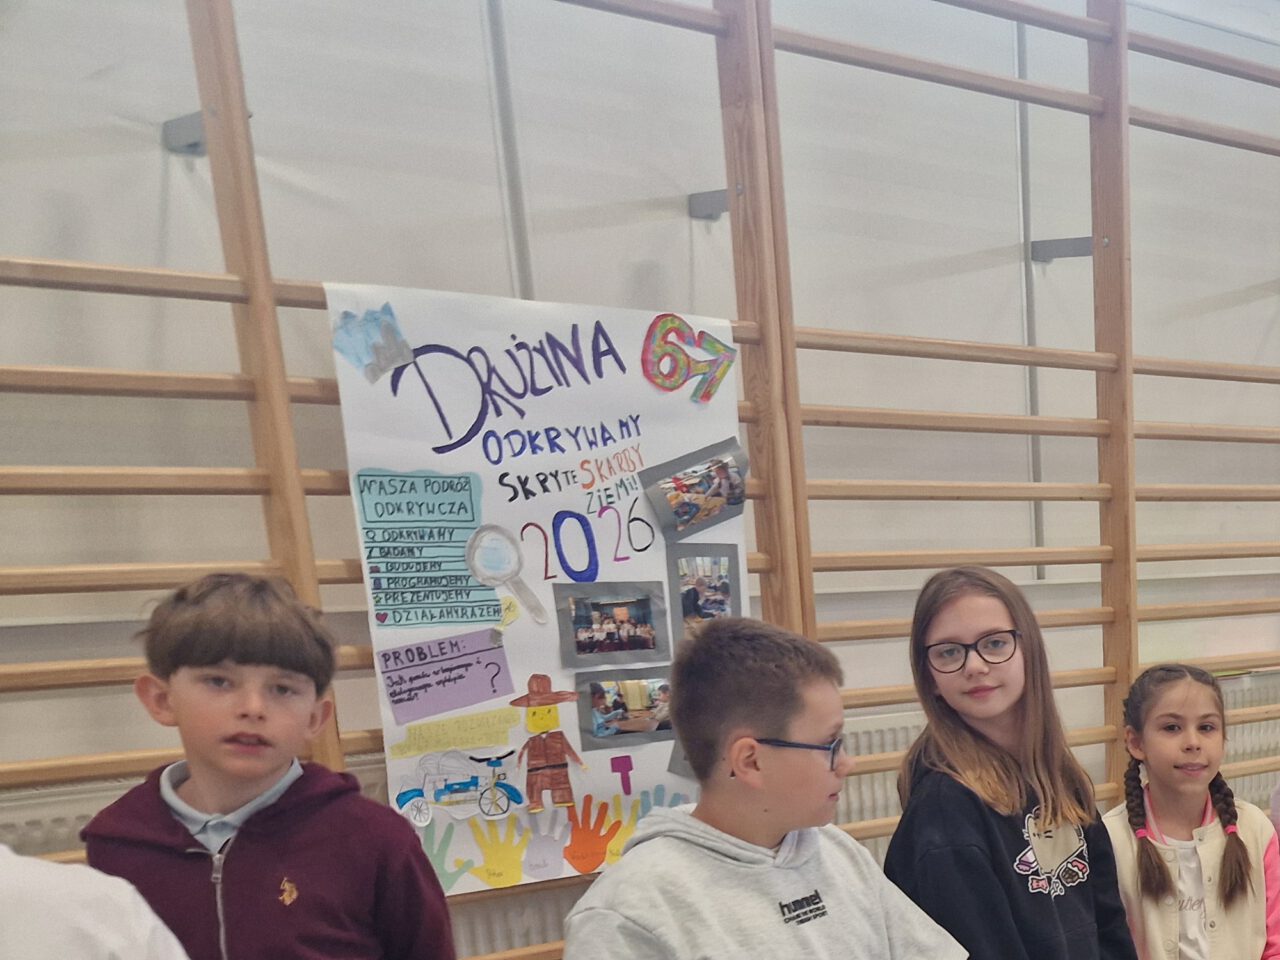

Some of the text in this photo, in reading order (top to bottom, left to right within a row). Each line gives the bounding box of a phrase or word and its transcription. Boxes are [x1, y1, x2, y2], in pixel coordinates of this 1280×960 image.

[391, 312, 738, 455] DRUŻYNA 67
[482, 413, 643, 466] ODKRYWAMY
[498, 443, 645, 503] SKRYTE SKARBY
[374, 501, 469, 519] ODKRYWCZA
[519, 497, 656, 583] 2026
